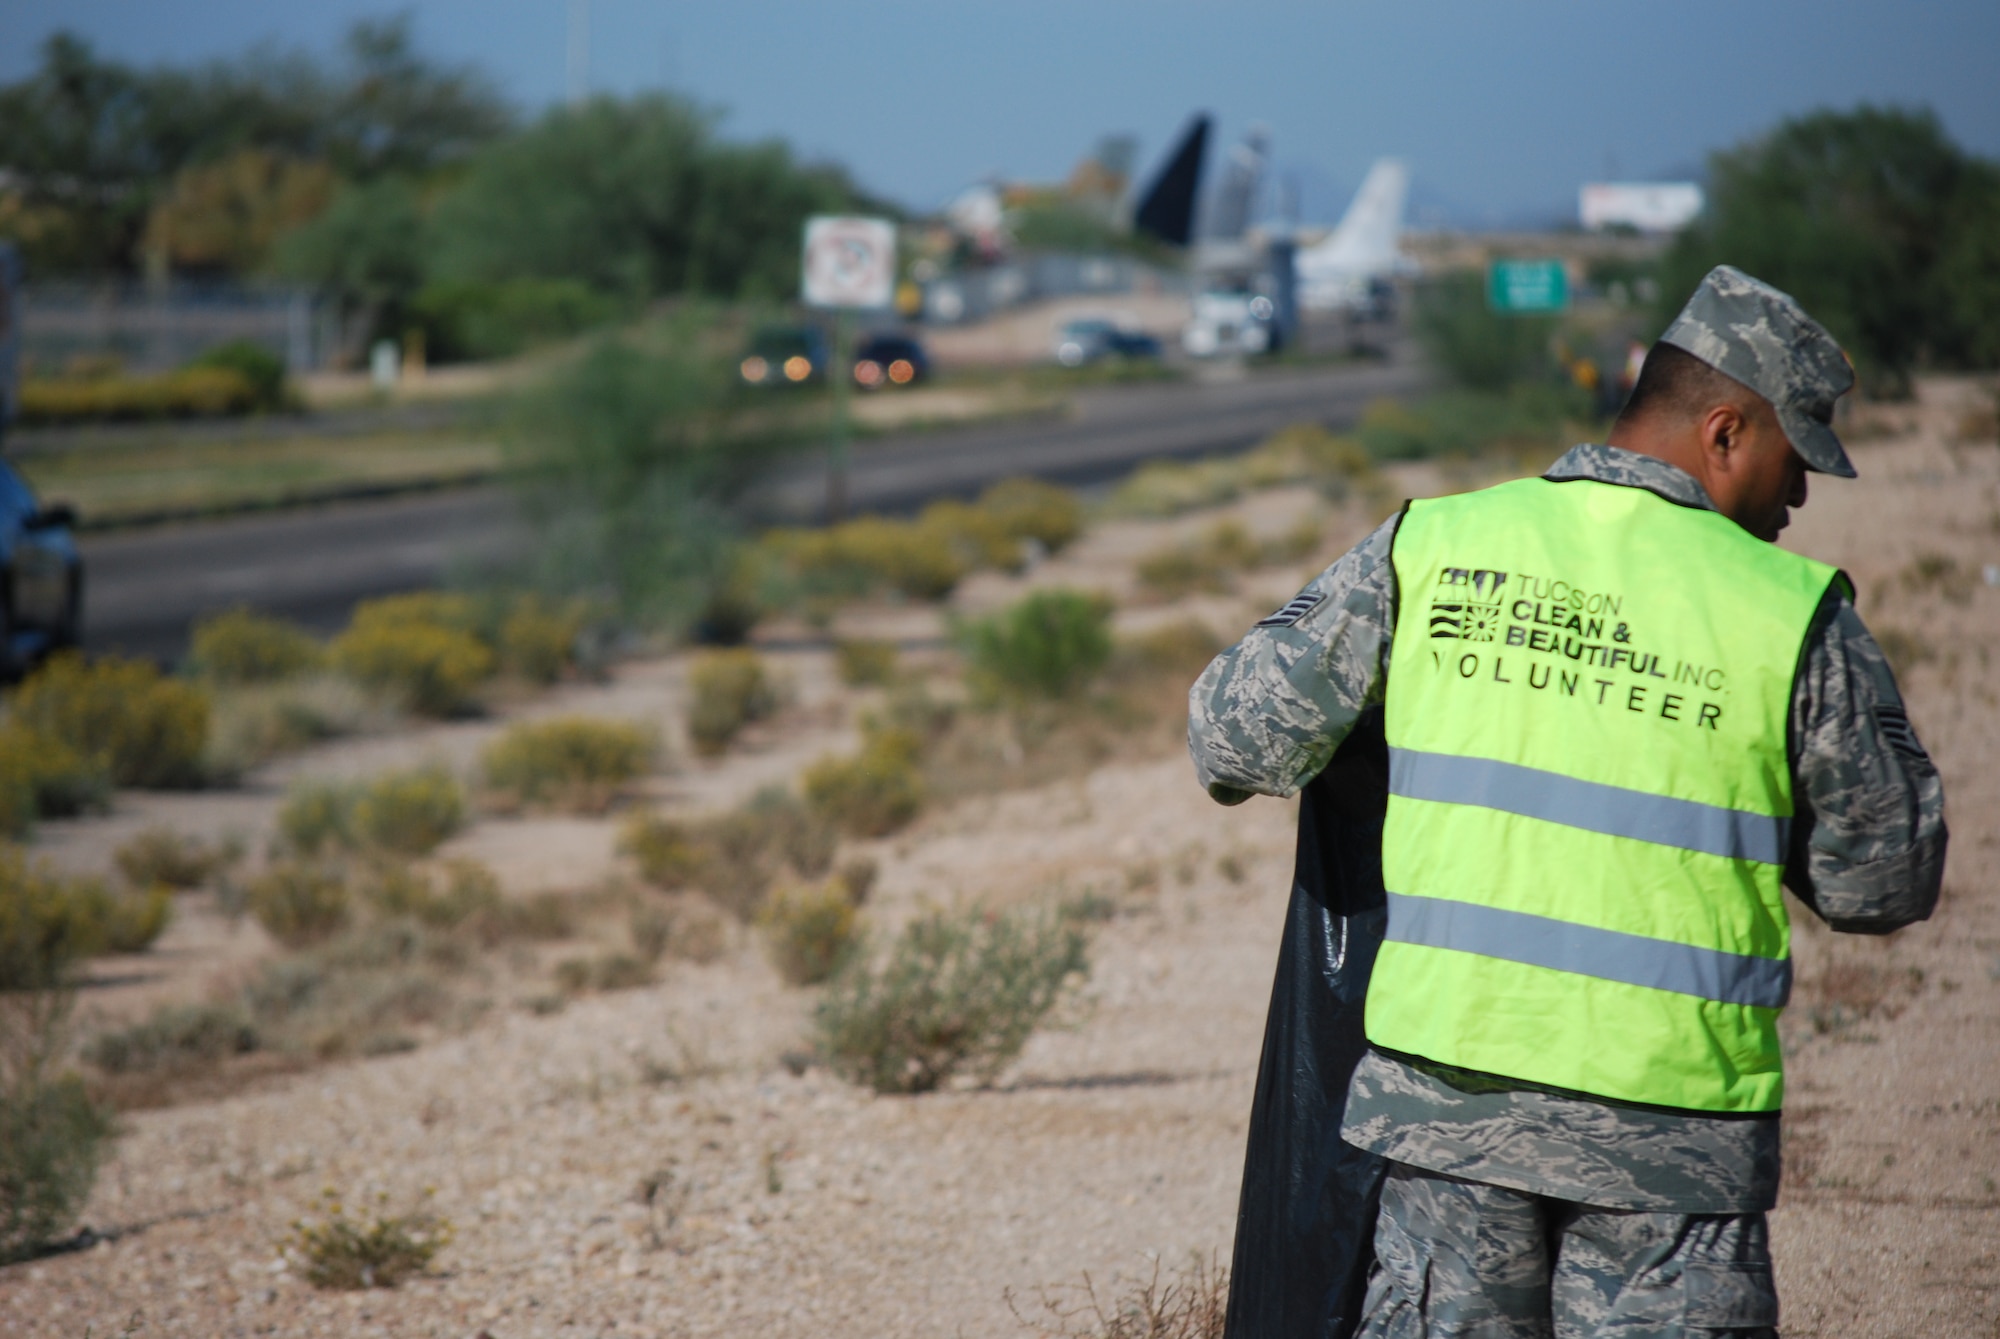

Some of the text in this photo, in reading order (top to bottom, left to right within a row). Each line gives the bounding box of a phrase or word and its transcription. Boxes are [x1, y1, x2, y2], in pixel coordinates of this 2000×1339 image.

[1512, 599, 1631, 644] CLEAN &
[1517, 573, 1623, 616] TUCSON
[1505, 624, 1731, 695] BEAUTIFUL INC.
[1432, 651, 1721, 730] VOLUNTEER
